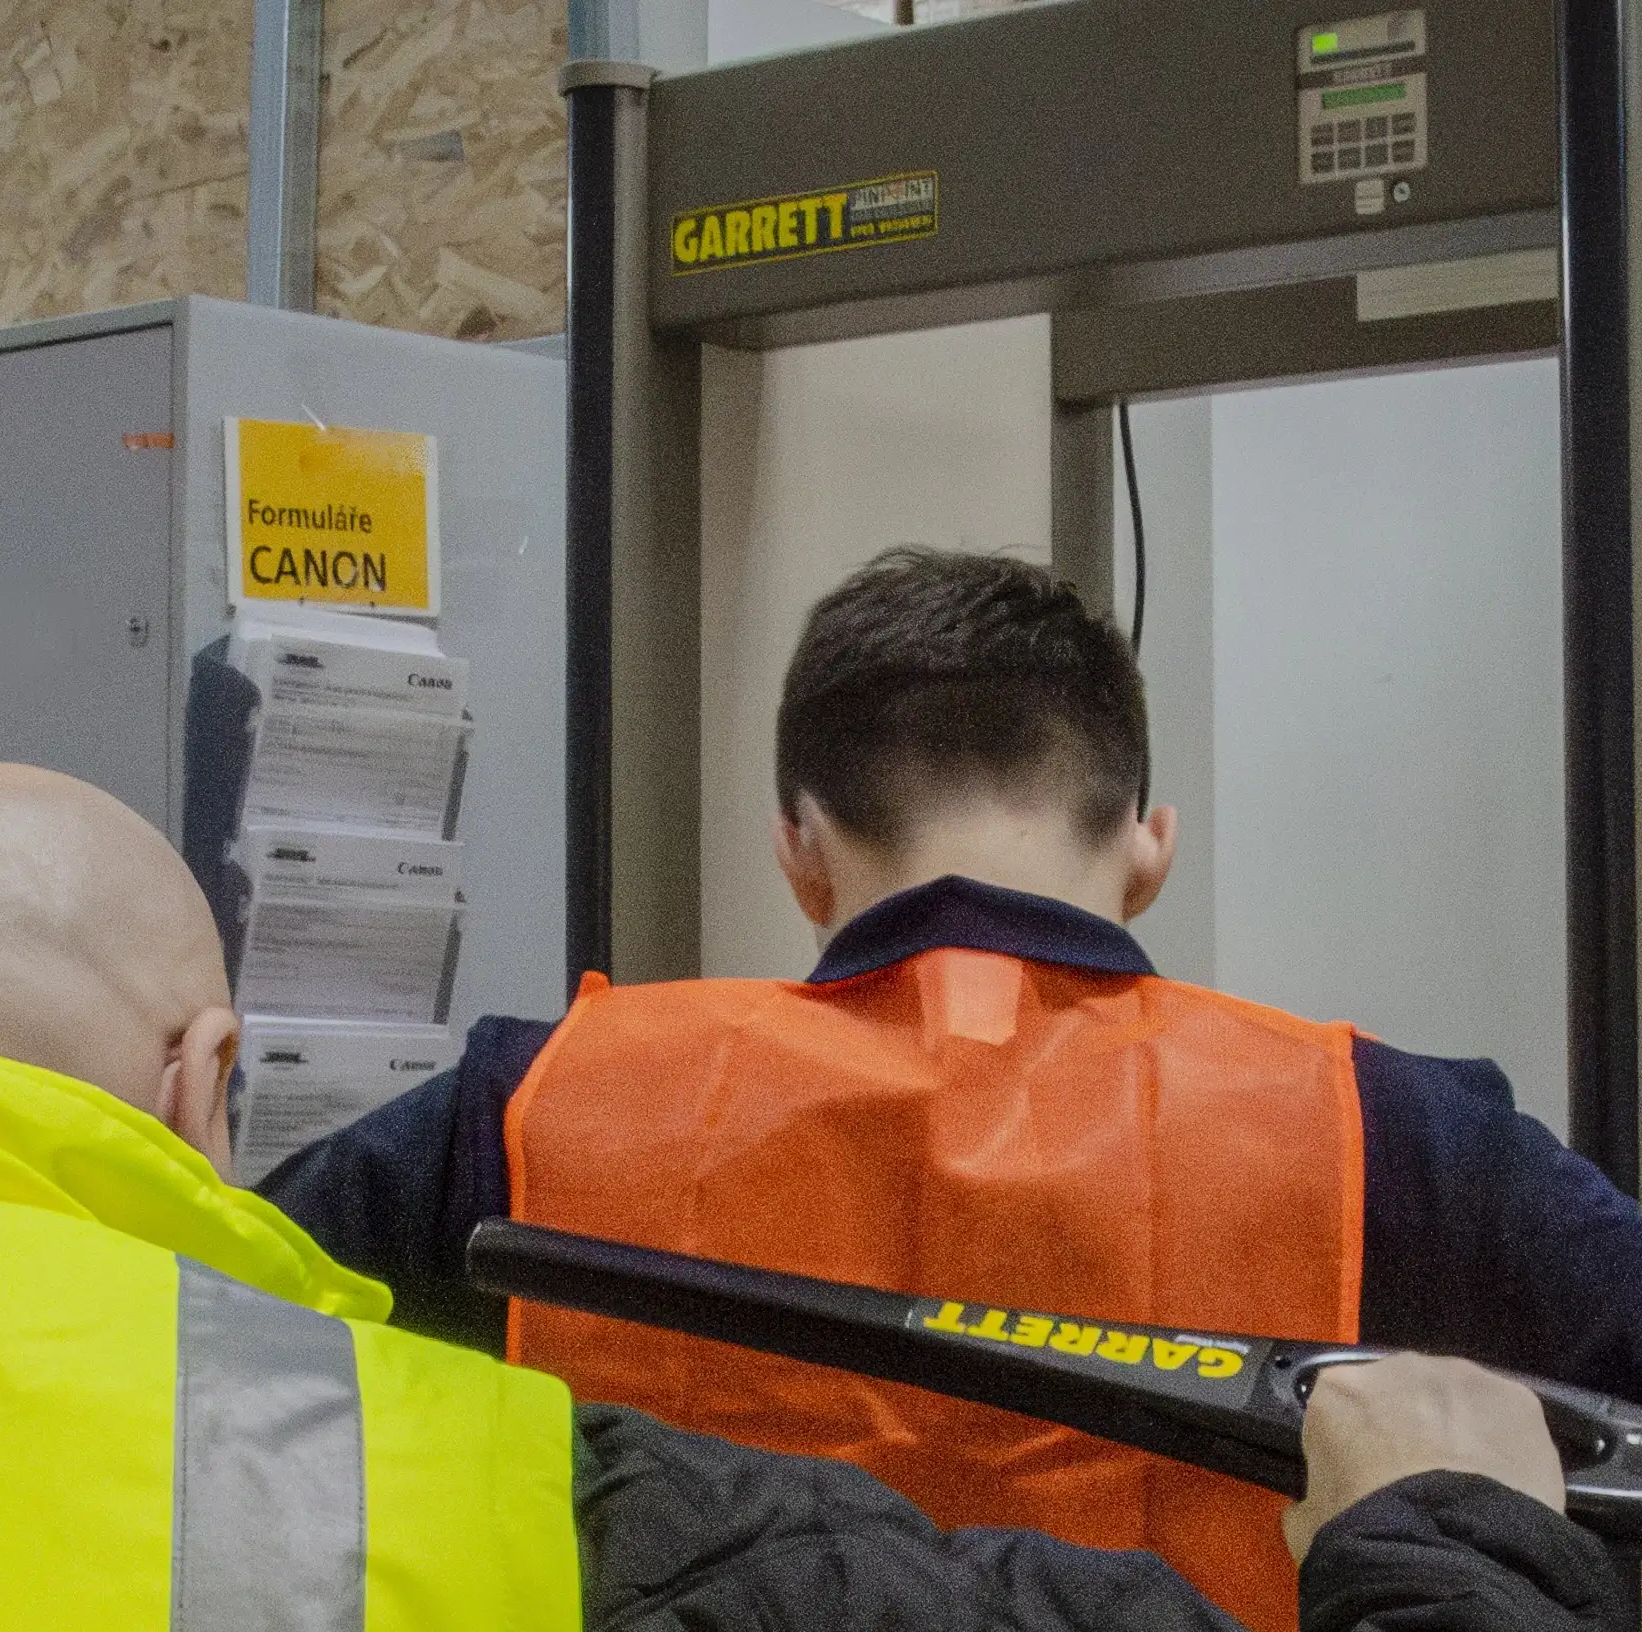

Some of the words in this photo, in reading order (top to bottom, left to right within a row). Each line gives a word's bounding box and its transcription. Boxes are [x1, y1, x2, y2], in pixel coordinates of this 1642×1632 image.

[674, 191, 848, 264] GARRETT
[247, 499, 374, 535] Formuláře
[249, 545, 388, 592] CANON
[924, 1301, 1244, 1379] GARRETT
